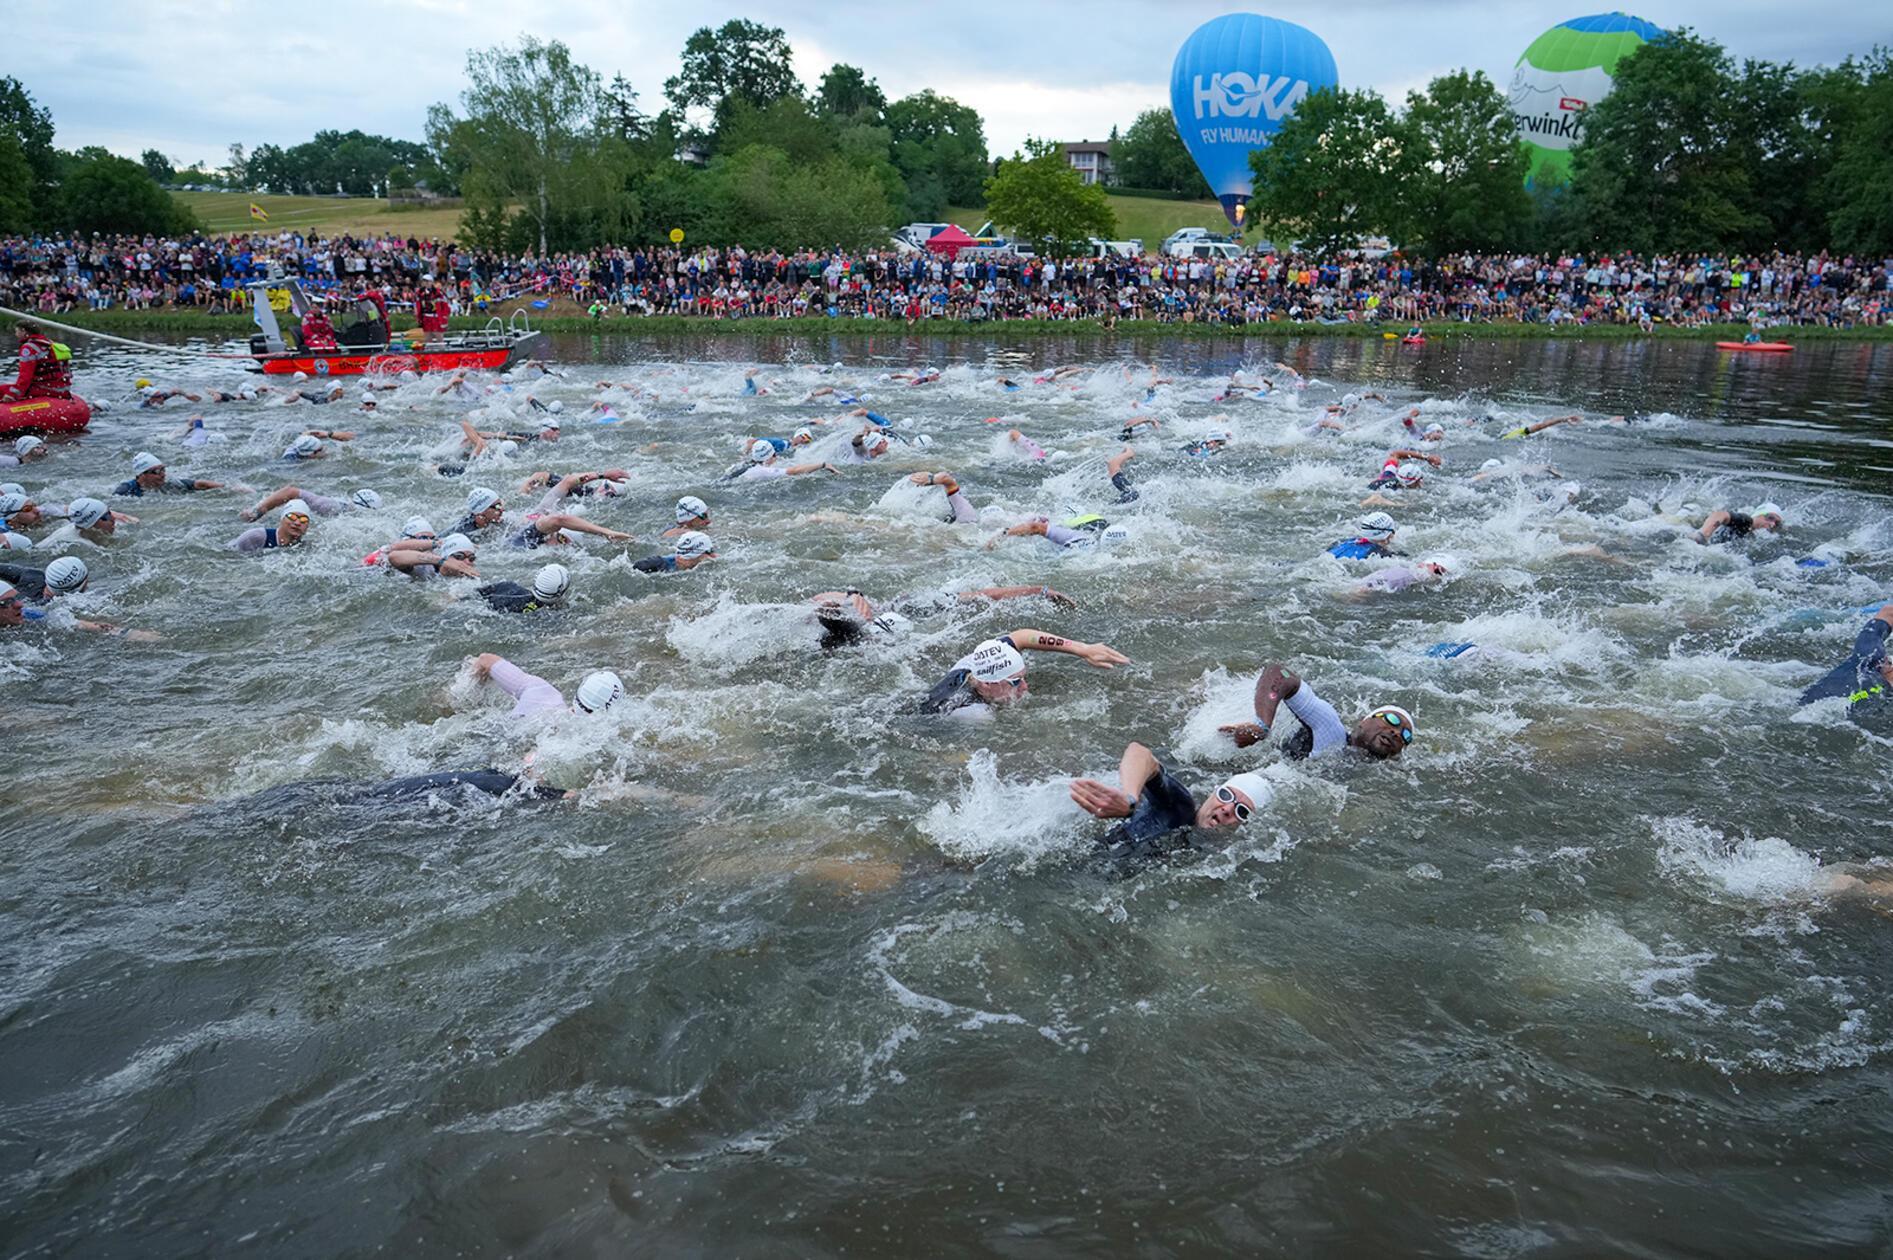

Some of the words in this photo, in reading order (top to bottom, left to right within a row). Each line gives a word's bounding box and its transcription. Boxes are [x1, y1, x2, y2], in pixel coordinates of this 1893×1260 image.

[1193, 72, 1308, 120] HOKA
[1201, 128, 1218, 144] FLY
[57, 565, 79, 586] DATEV
[974, 646, 1001, 661] DATEV
[977, 660, 1012, 675] sailfish
